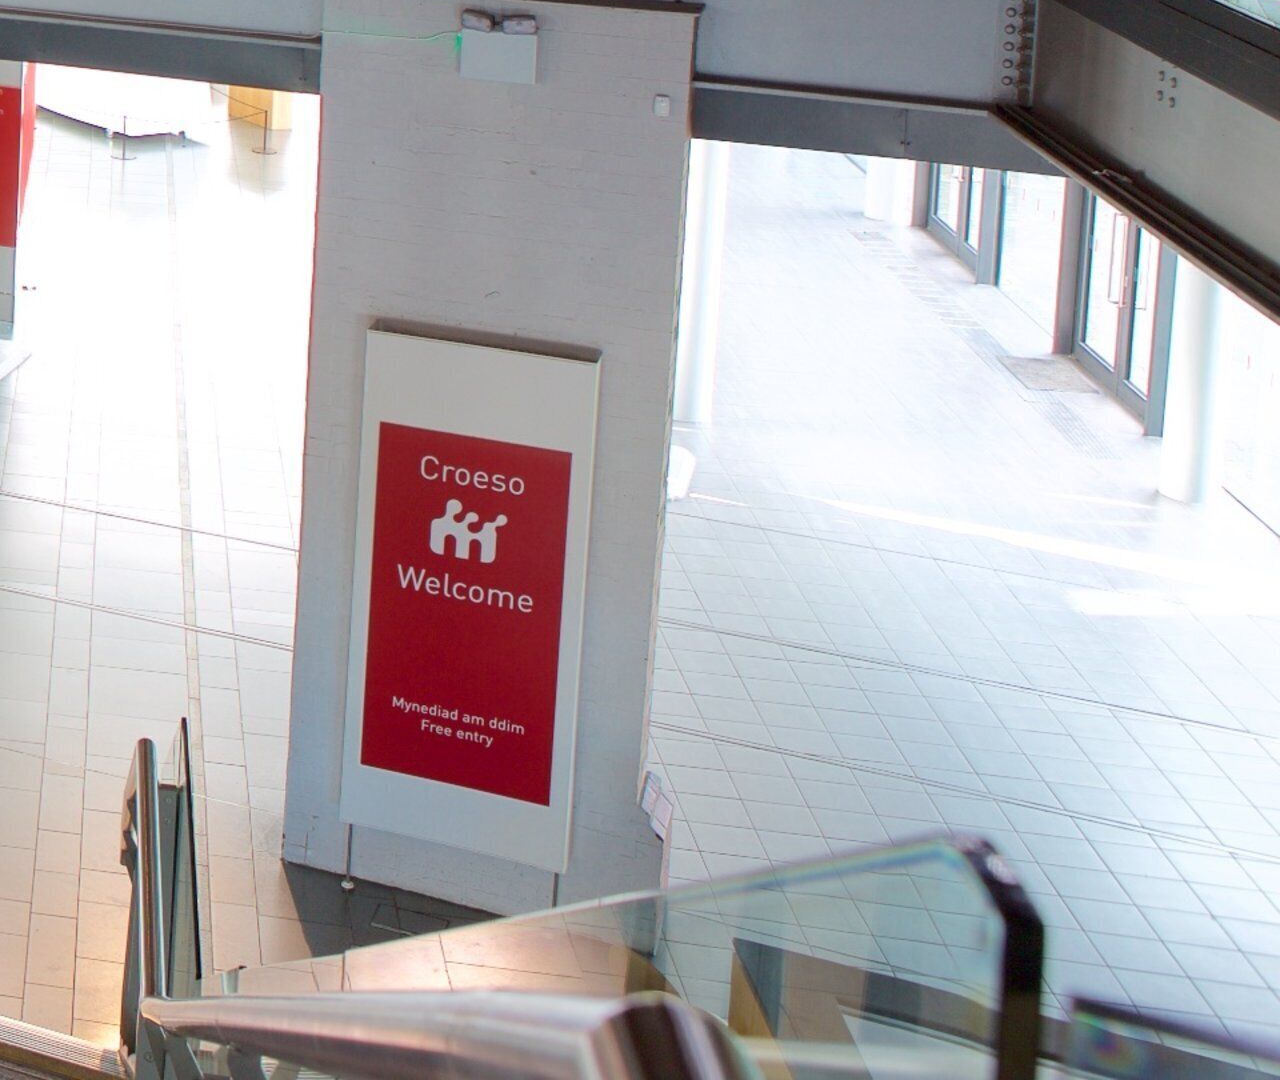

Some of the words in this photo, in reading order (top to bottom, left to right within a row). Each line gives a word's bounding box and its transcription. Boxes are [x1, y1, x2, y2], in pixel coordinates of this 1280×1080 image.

[420, 455, 525, 495] Croeso
[397, 563, 533, 613] Welcome
[392, 695, 459, 721] Mynediad
[462, 713, 485, 726] am
[488, 717, 525, 735] ddim
[421, 719, 453, 737] Free
[456, 729, 494, 748] entry
